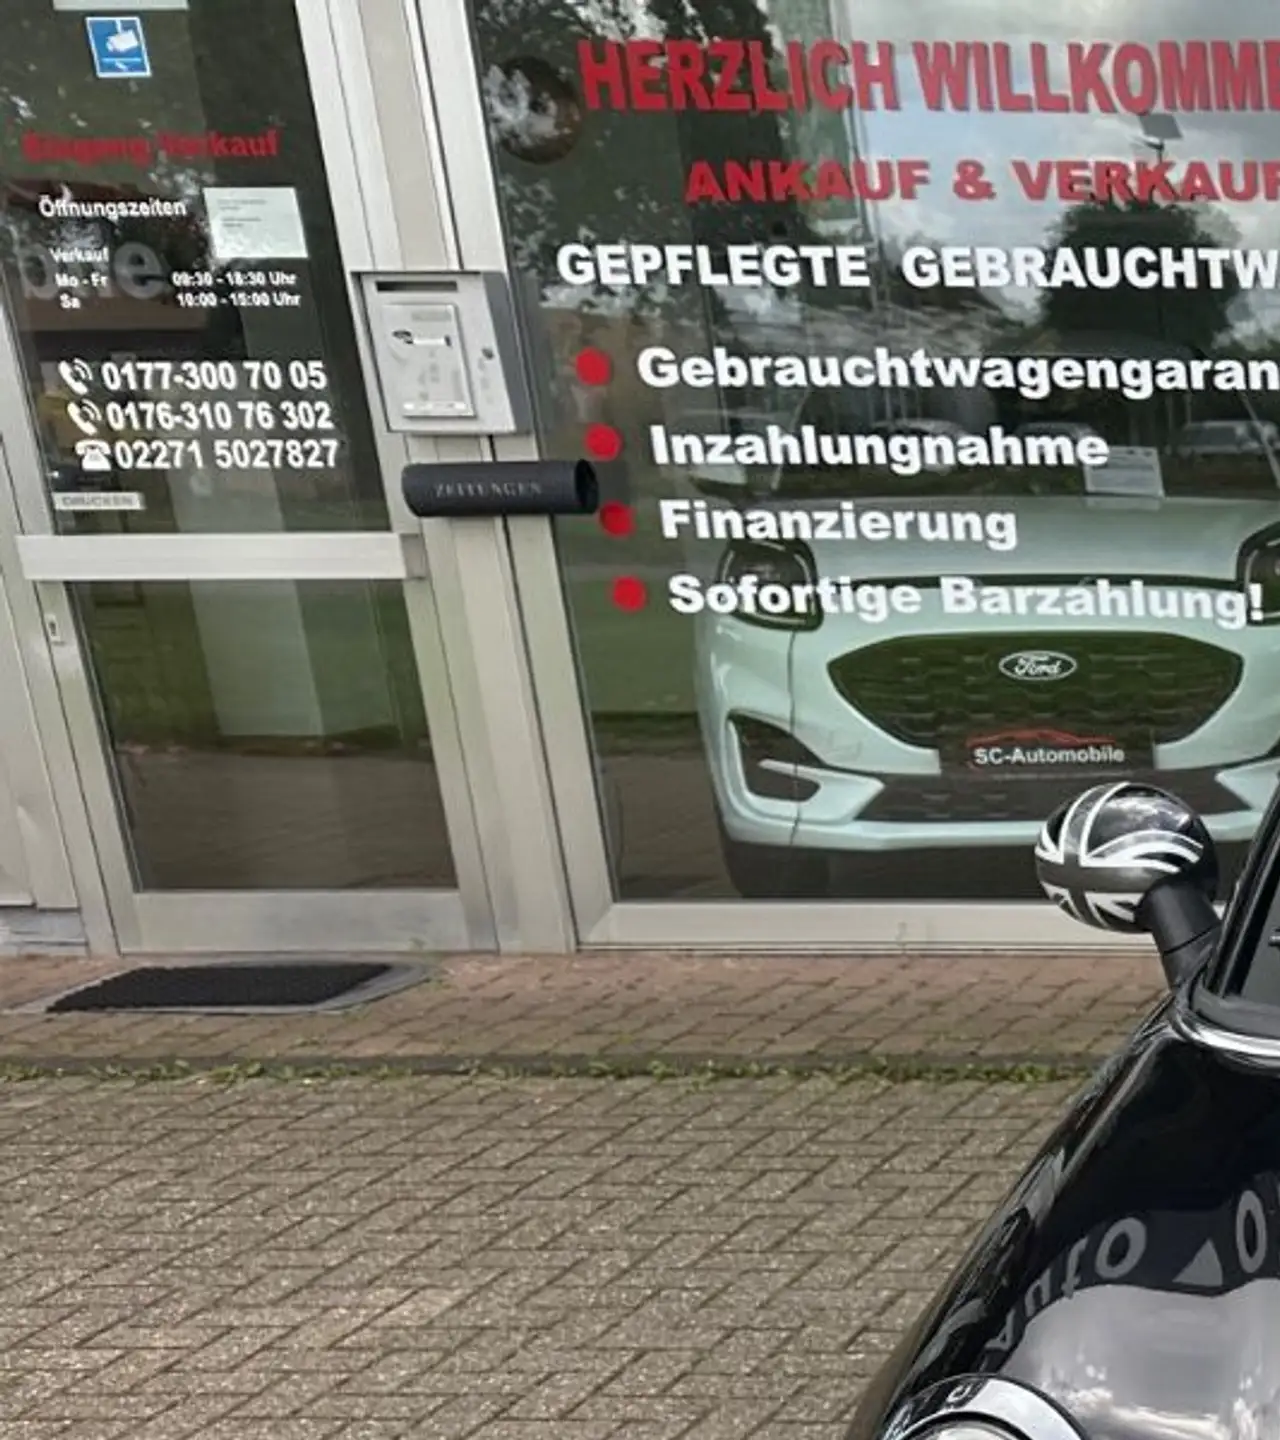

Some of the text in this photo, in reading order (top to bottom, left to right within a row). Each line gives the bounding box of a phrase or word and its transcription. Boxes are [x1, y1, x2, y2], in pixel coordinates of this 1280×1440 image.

[579, 39, 899, 111] HERZLICH
[685, 160, 929, 202] ANKAUF
[953, 161, 996, 200] &
[38, 195, 188, 219] Öffnungszeiten
[50, 247, 110, 263] Verkauf
[556, 243, 871, 288] GEPFLEGTE
[54, 273, 81, 288] Mo
[268, 271, 297, 286] Uhr
[59, 293, 81, 309] Sa
[272, 292, 301, 307] Uhr
[100, 360, 328, 391] 0177-300 70 05
[106, 400, 335, 431] 0176-310 76 302
[114, 438, 339, 469] 02271 5027827
[650, 424, 1110, 474] Inzahlungnahme
[659, 499, 1018, 551] Finanzierung
[668, 574, 1264, 630] Sofortige Barzahlung!
[1013, 654, 1063, 676] Ford
[973, 745, 1126, 766] SC-Automobile
